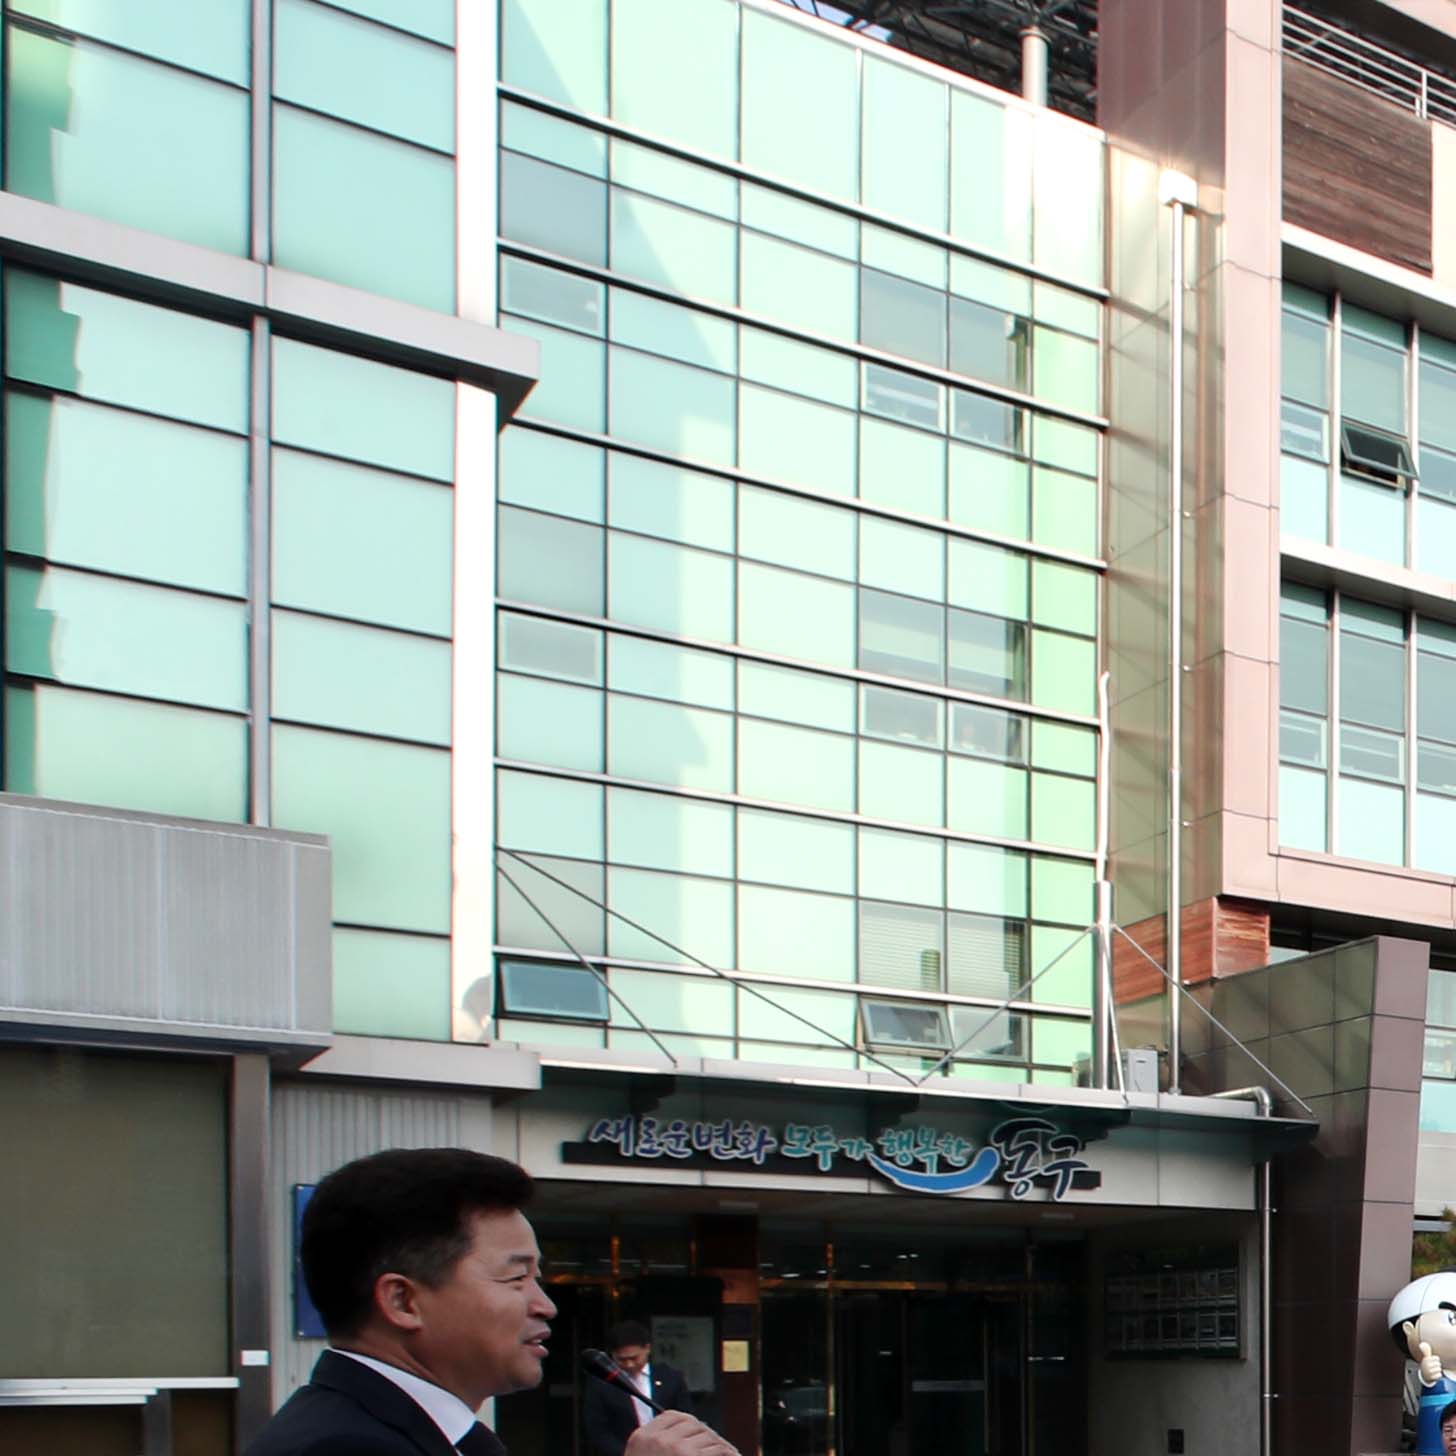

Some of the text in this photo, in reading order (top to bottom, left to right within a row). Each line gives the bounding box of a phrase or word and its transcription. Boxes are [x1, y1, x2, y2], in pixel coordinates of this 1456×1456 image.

[588, 1115, 1091, 1201] 새로운 변화 모두가 행복한 동구
